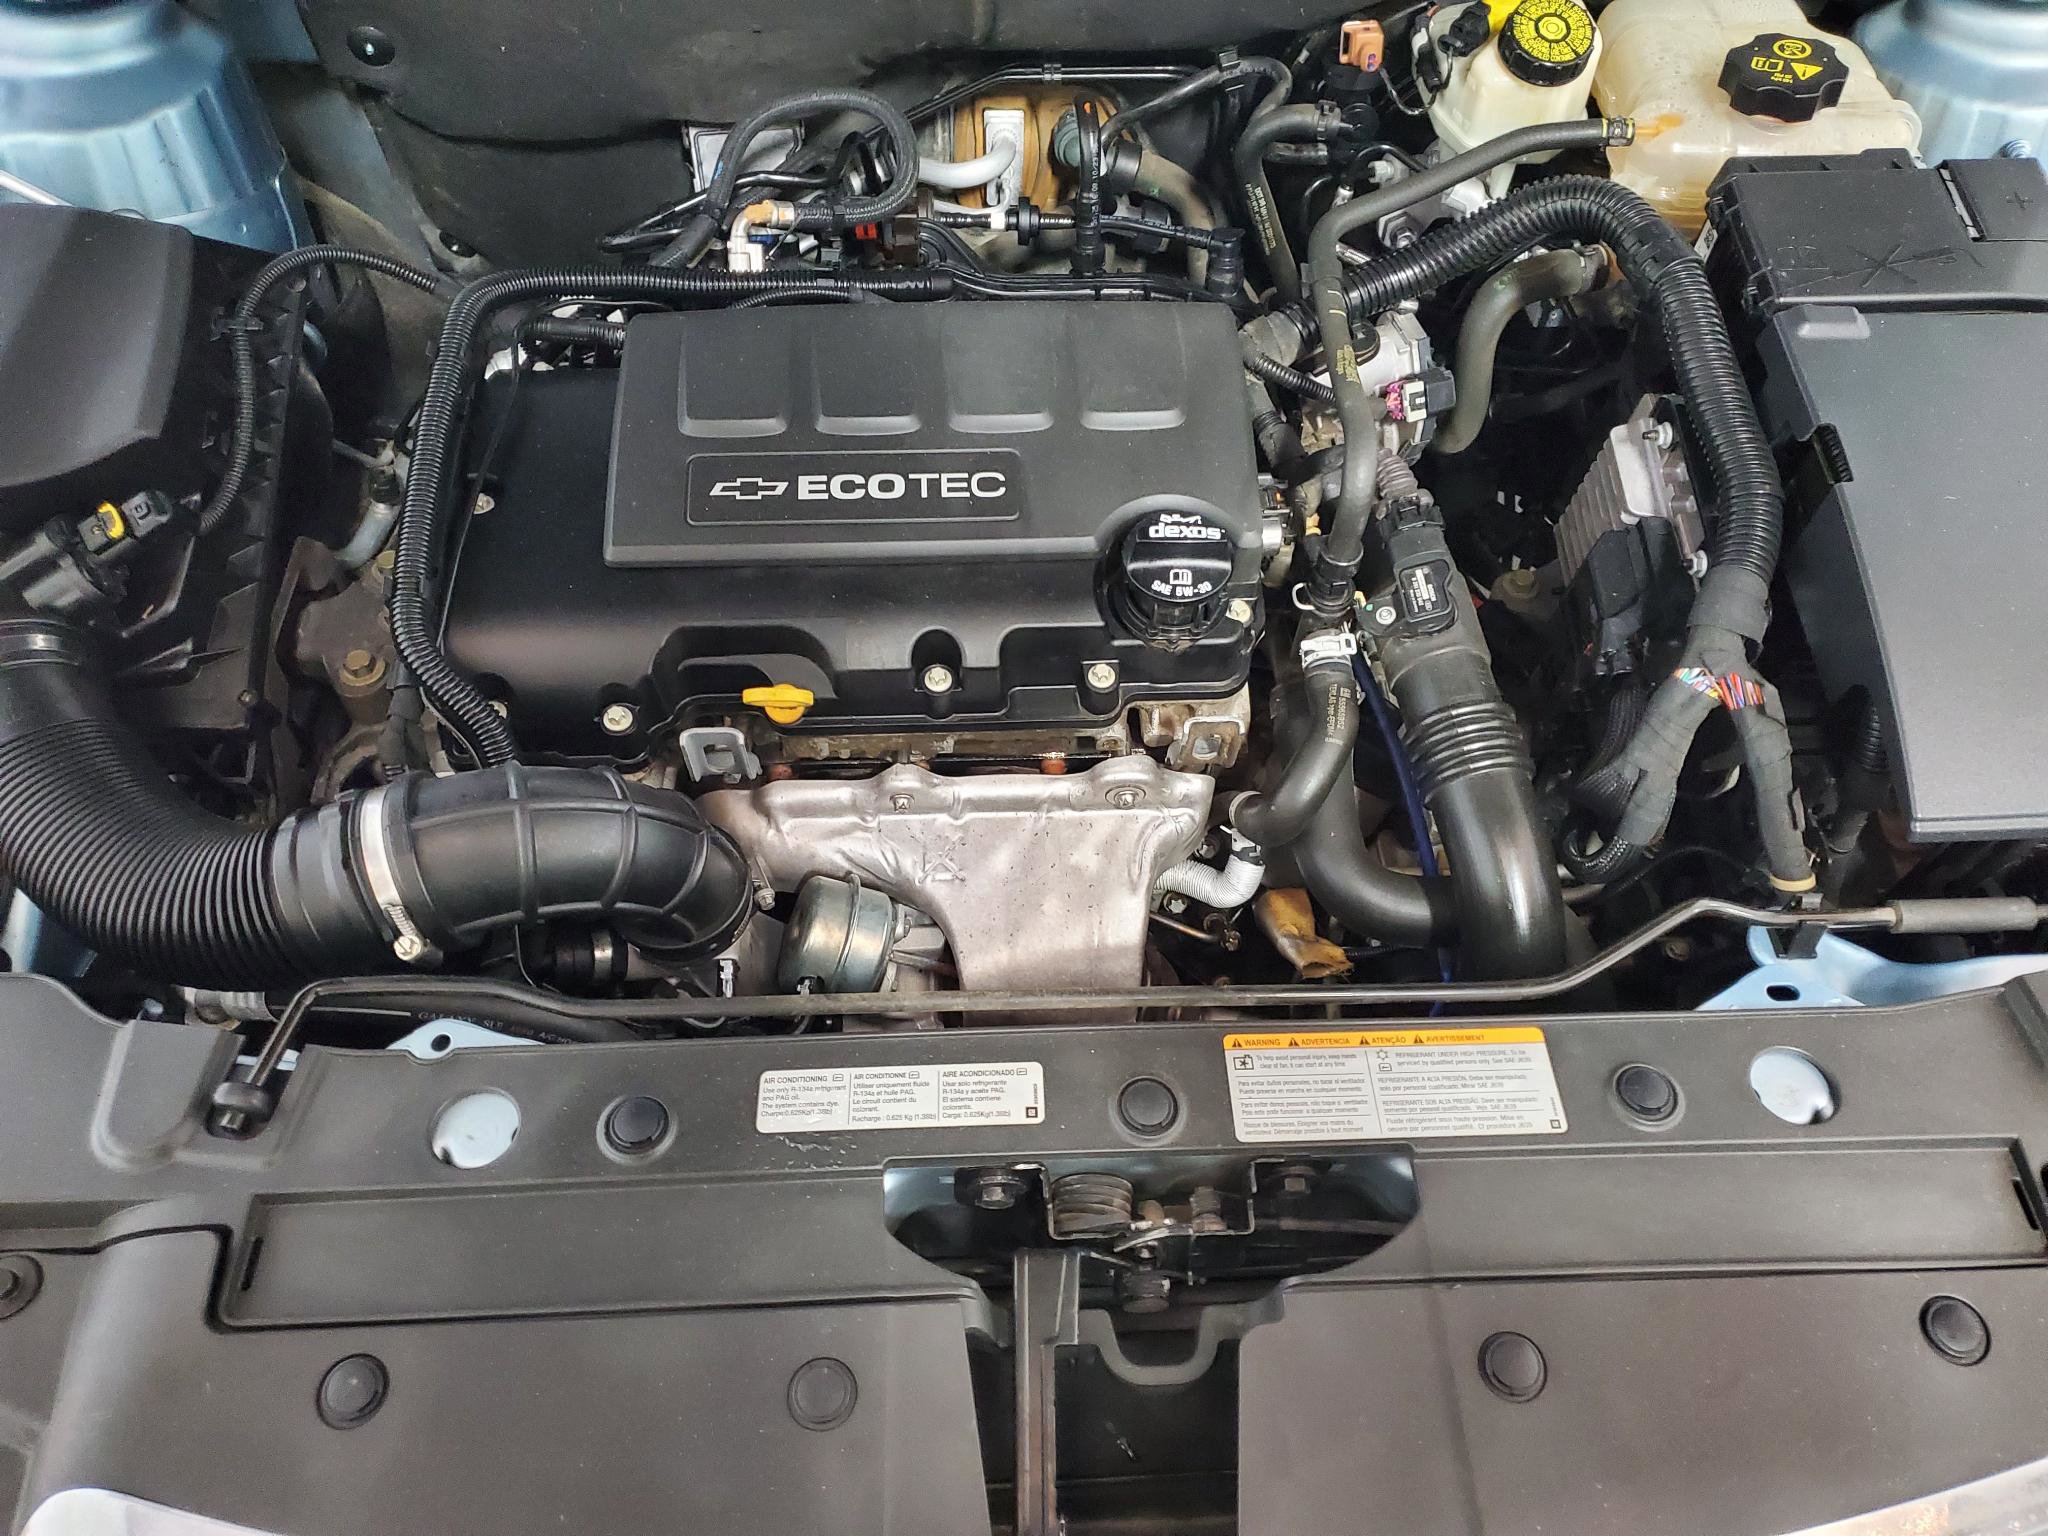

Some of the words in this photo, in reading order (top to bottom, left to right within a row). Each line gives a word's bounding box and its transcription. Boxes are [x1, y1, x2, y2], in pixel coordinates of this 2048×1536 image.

[798, 472, 1006, 500] ECOTEC
[1148, 522, 1221, 540] dexos
[1151, 580, 1172, 596] SAE
[1176, 581, 1212, 596] 5W-30
[1302, 1038, 1350, 1046] ADVERTENCIA
[958, 1069, 1014, 1077] ACONDICIONADO
